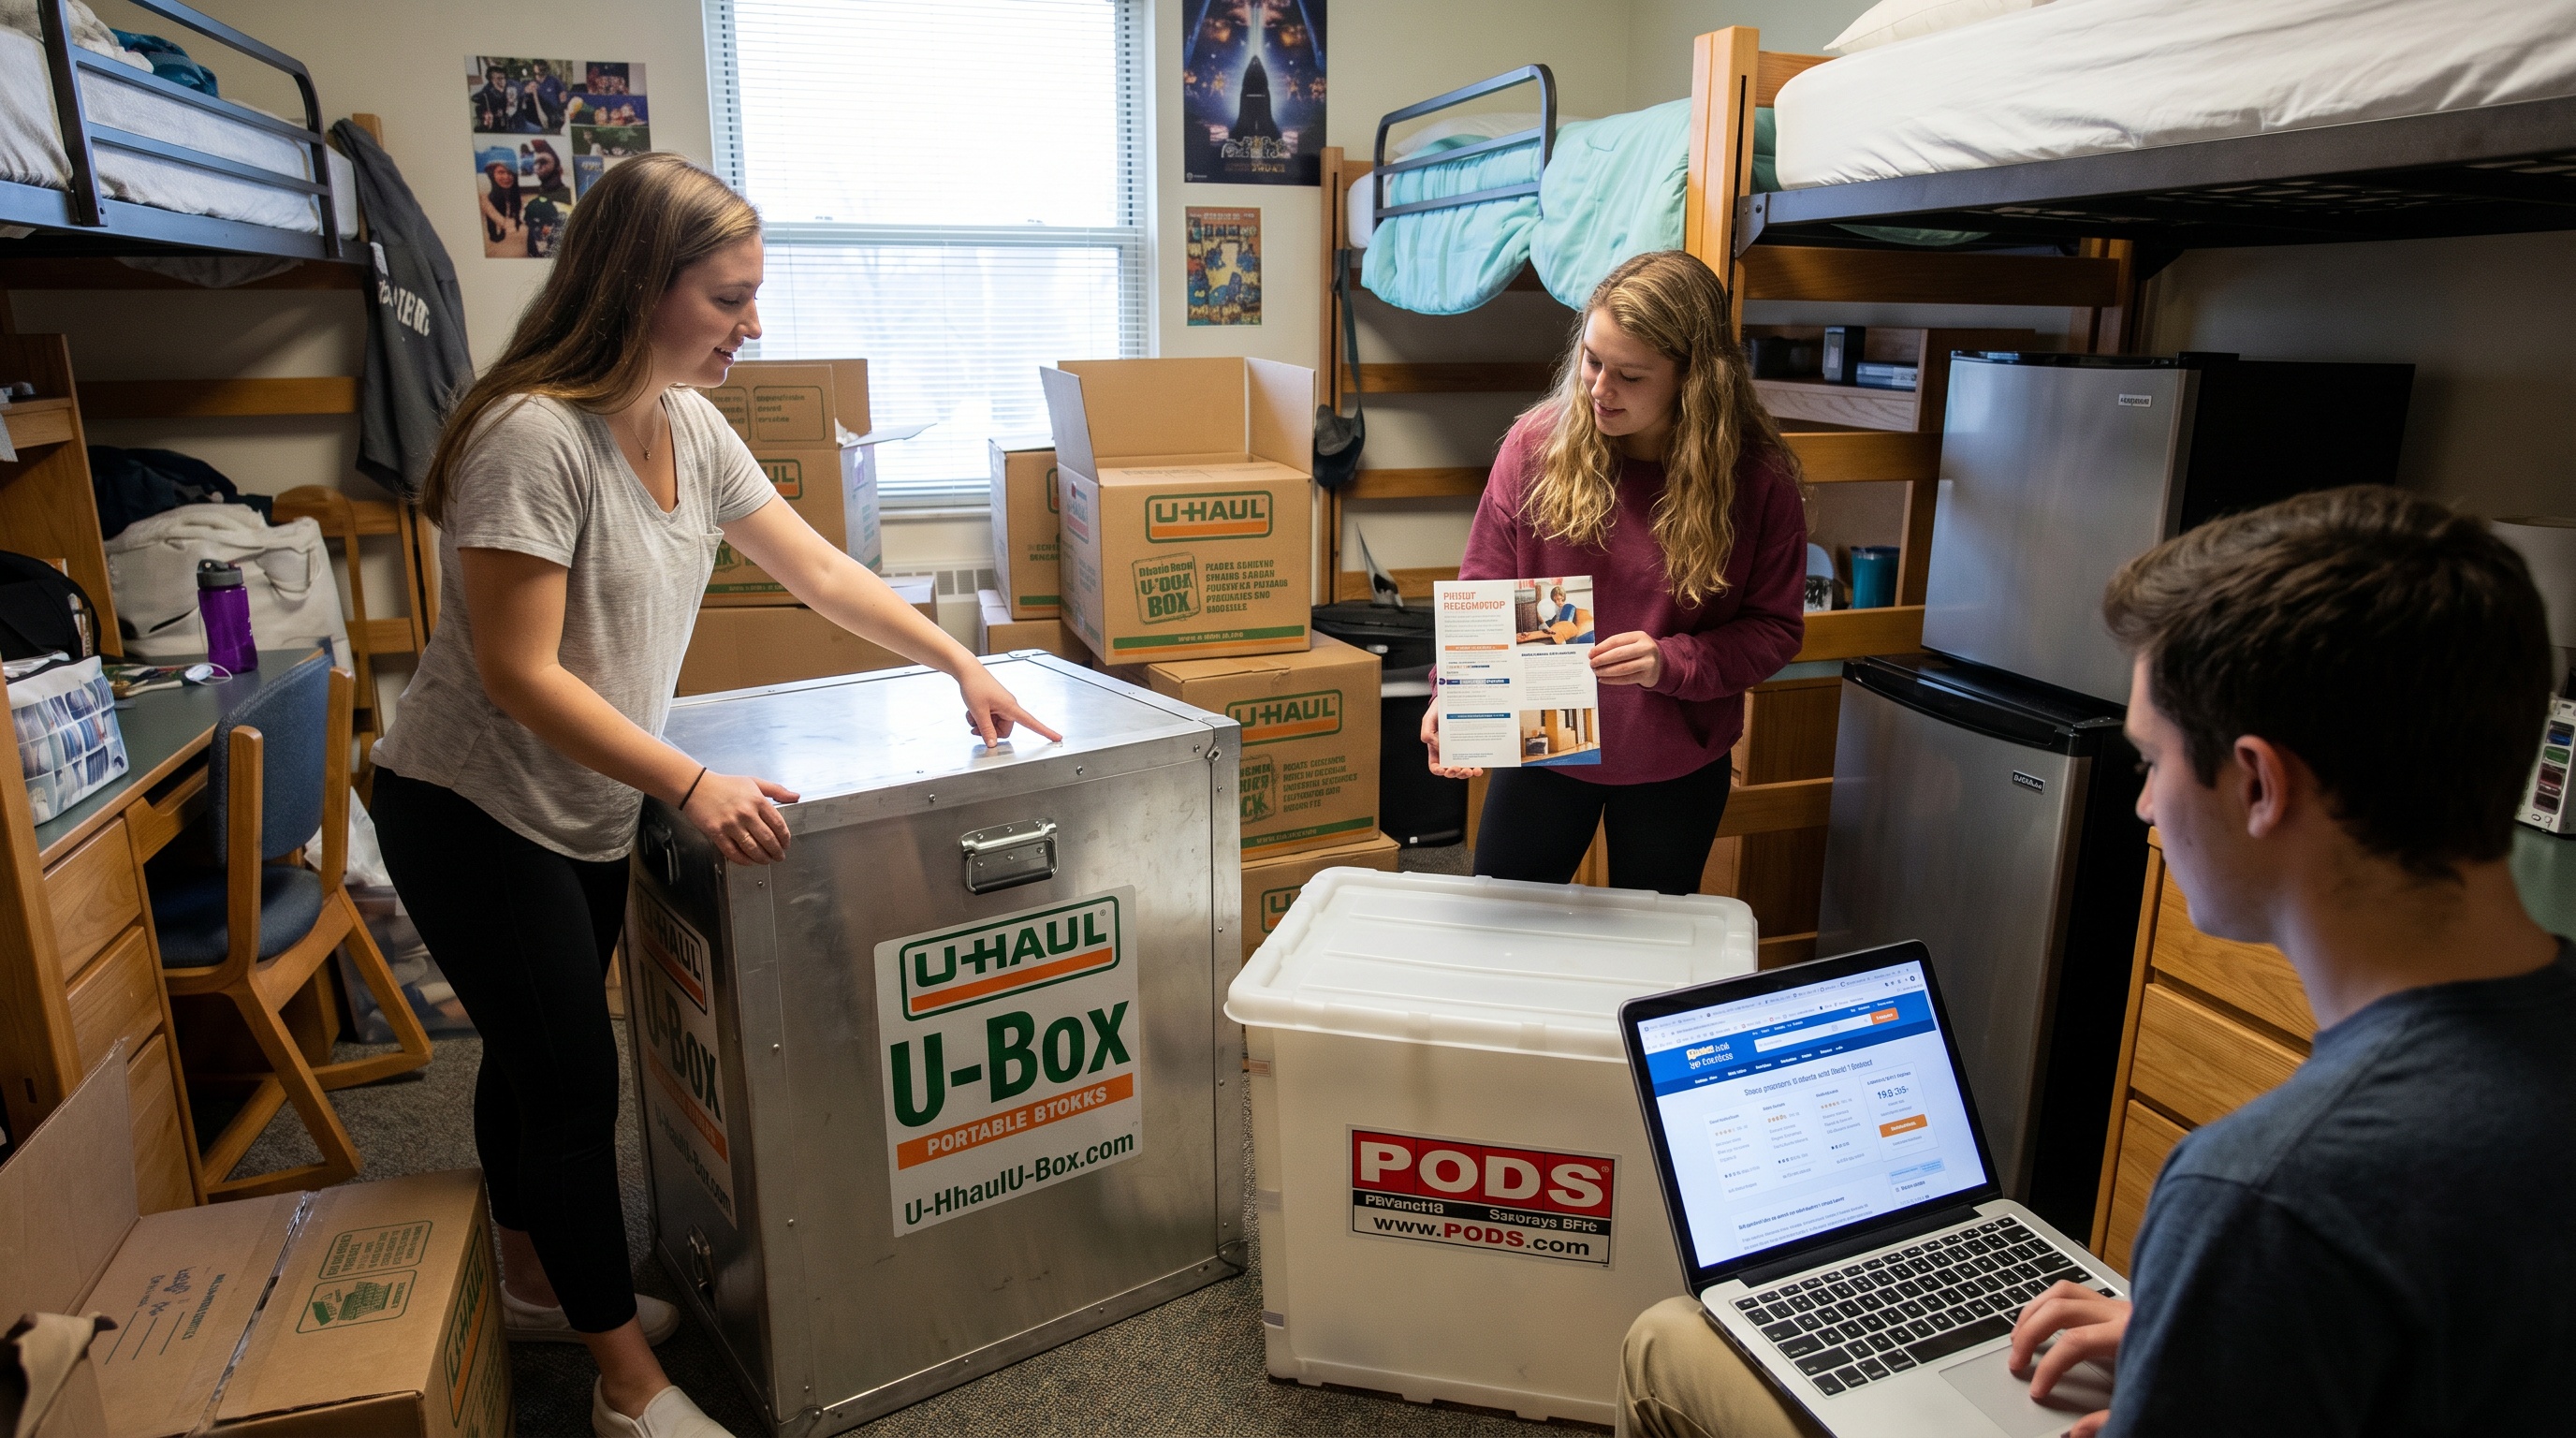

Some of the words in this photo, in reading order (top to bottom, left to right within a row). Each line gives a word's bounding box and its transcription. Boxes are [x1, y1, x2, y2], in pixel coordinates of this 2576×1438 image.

[1154, 498, 1266, 523] U-HAUL
[1148, 591, 1191, 619] BOX
[1235, 697, 1337, 727] U-HAUL
[914, 911, 1107, 989] U-HAUL
[927, 1110, 1028, 1157] PORTABLE
[1034, 1086, 1107, 1123] BTOKKS
[904, 1132, 1134, 1226] U-HhaulU-Box.com
[1359, 1140, 1604, 1208] PODS
[1372, 1217, 1590, 1256] www.PODS.com
